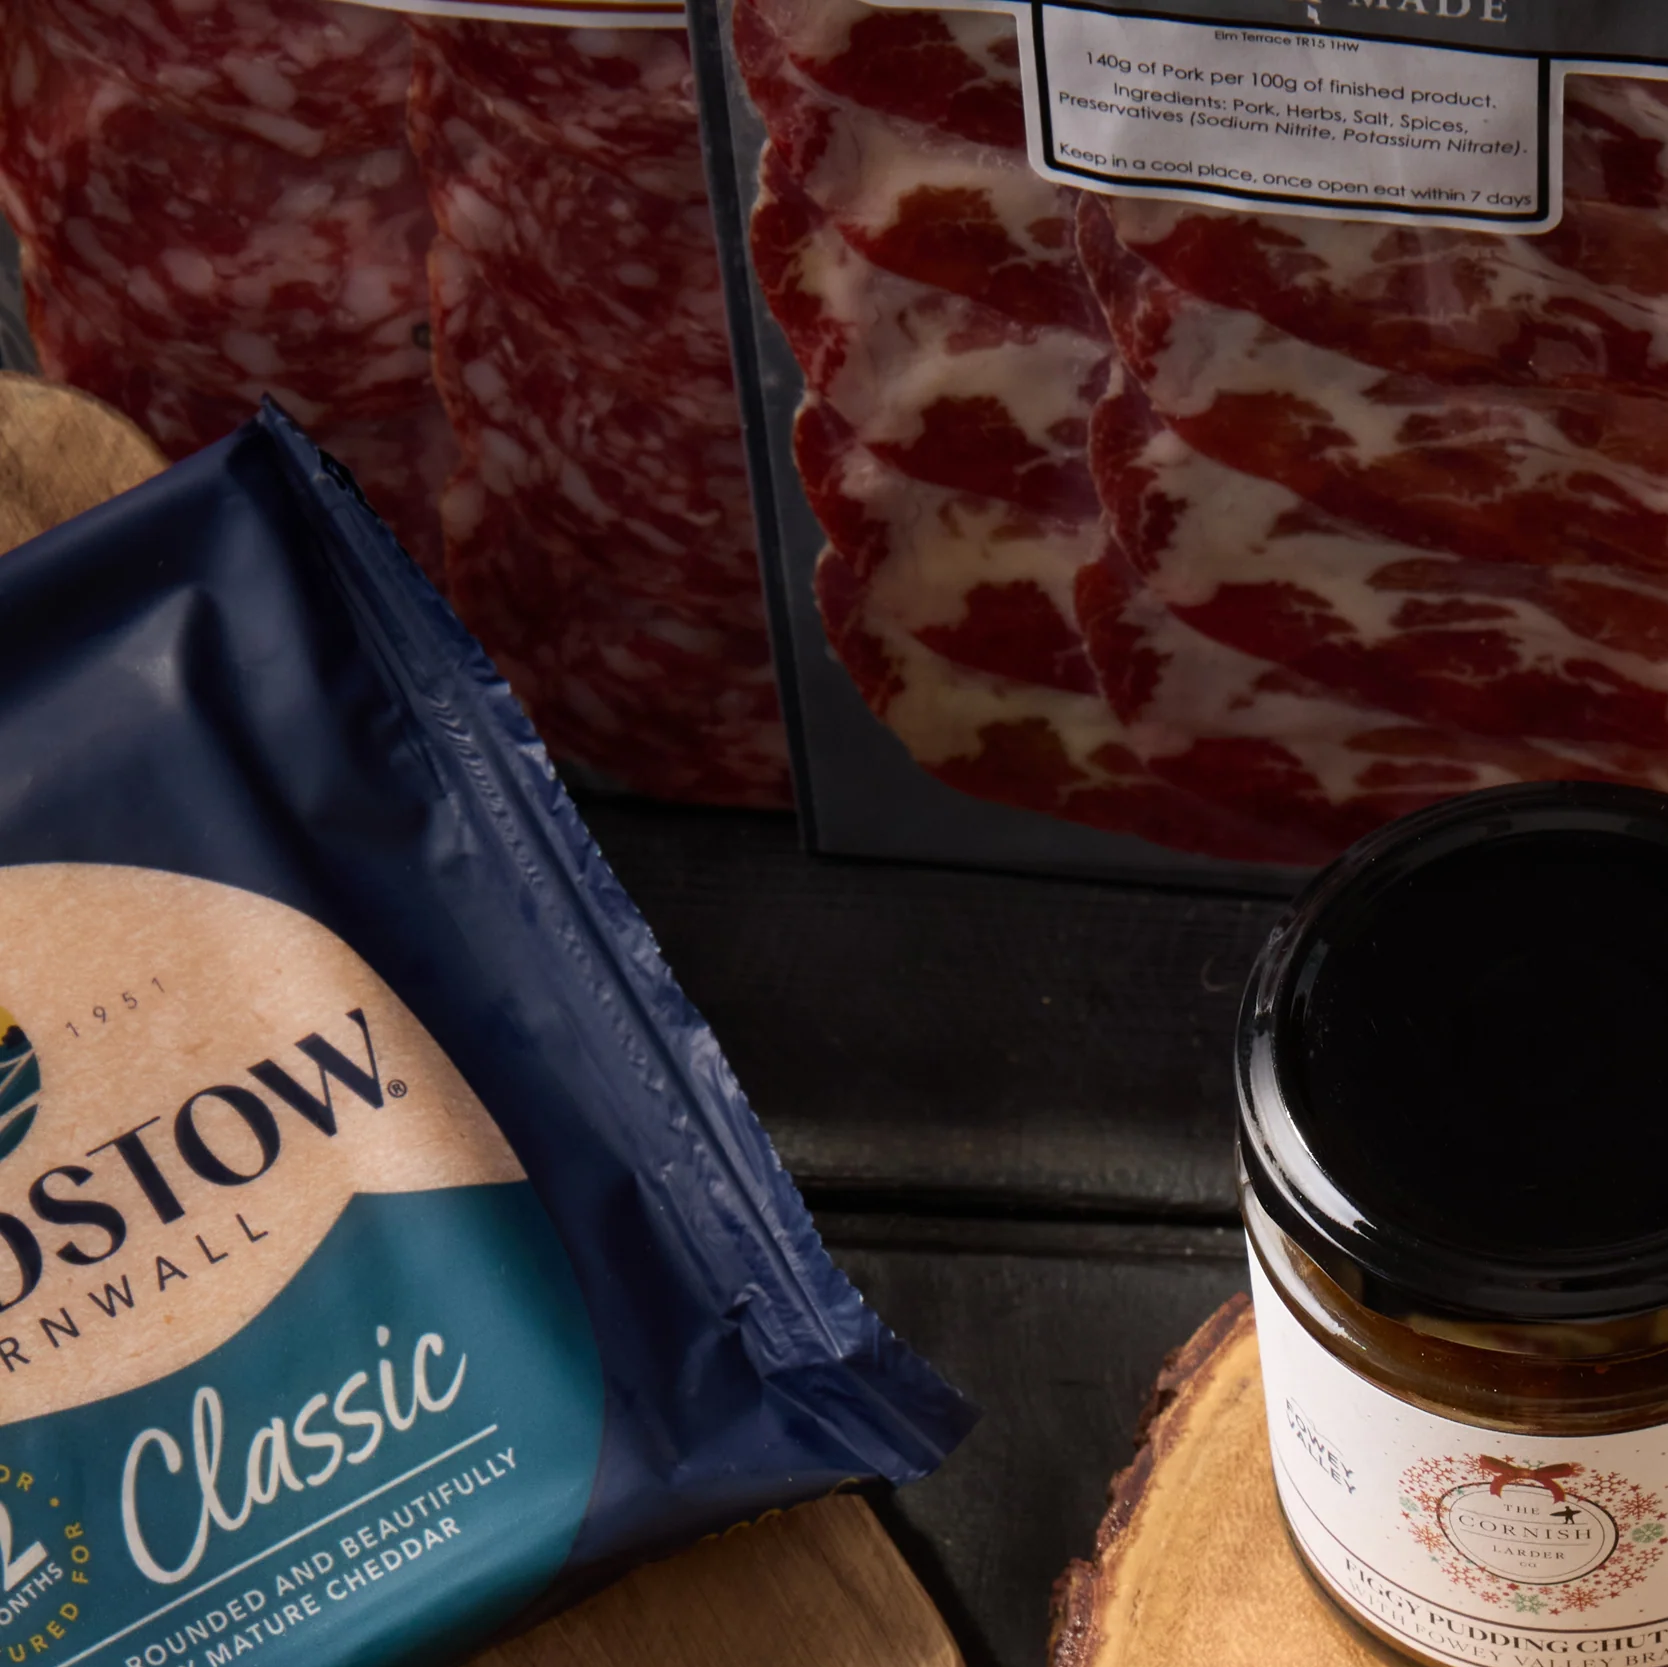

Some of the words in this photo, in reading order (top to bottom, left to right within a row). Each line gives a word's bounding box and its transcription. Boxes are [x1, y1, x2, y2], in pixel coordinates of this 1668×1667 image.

[1214, 30, 1238, 41] Elm
[1242, 31, 1292, 46] Terrace
[1296, 36, 1326, 49] TR15
[1087, 51, 1132, 73] 140g
[1137, 61, 1157, 75] of
[1162, 64, 1205, 82] Pork
[1210, 71, 1244, 86] per
[1251, 72, 1297, 93] 100g
[1303, 78, 1324, 93] of
[1330, 79, 1405, 100] finished
[1411, 90, 1497, 109] product.
[1113, 82, 1227, 111] Ingredients:
[1232, 98, 1281, 118] Pork,
[1286, 104, 1347, 124] Herbs,
[1353, 109, 1394, 127] Salt,
[1400, 114, 1469, 134] Spices,
[1058, 91, 1184, 123] Preservatives
[1189, 111, 1269, 132] (Sodium
[1275, 121, 1336, 141] Nitrite,
[1342, 128, 1441, 151] Potassium
[1447, 139, 1528, 157] Nitrate).
[1059, 142, 1107, 167] Keep
[1112, 154, 1128, 170] in
[1132, 159, 1146, 170] a
[1151, 158, 1193, 174] cool
[1198, 162, 1257, 184] place,
[1263, 173, 1312, 188] once
[1318, 178, 1368, 194] open
[1374, 184, 1406, 198] eat
[1411, 186, 1465, 202] within
[1470, 191, 1481, 203] 7
[1486, 191, 1532, 208] days
[66, 977, 165, 1038] 1951
[121, 1324, 467, 1585] Classic
[1285, 1397, 1354, 1478] FOWEY
[1286, 1409, 1357, 1495] VALLEY
[275, 1552, 334, 1597] AND
[340, 1447, 517, 1558] BEAUTIFULLY
[1458, 1514, 1592, 1541] CORNISH
[1502, 1502, 1541, 1516] THE
[64, 1521, 90, 1584] FOR
[326, 1516, 461, 1601] CHEDDAR
[1492, 1544, 1565, 1560] LARDER
[1344, 1557, 1422, 1617] FIGGY
[1429, 1610, 1569, 1654] PUDDING
[1415, 1622, 1503, 1662] FOWEY
